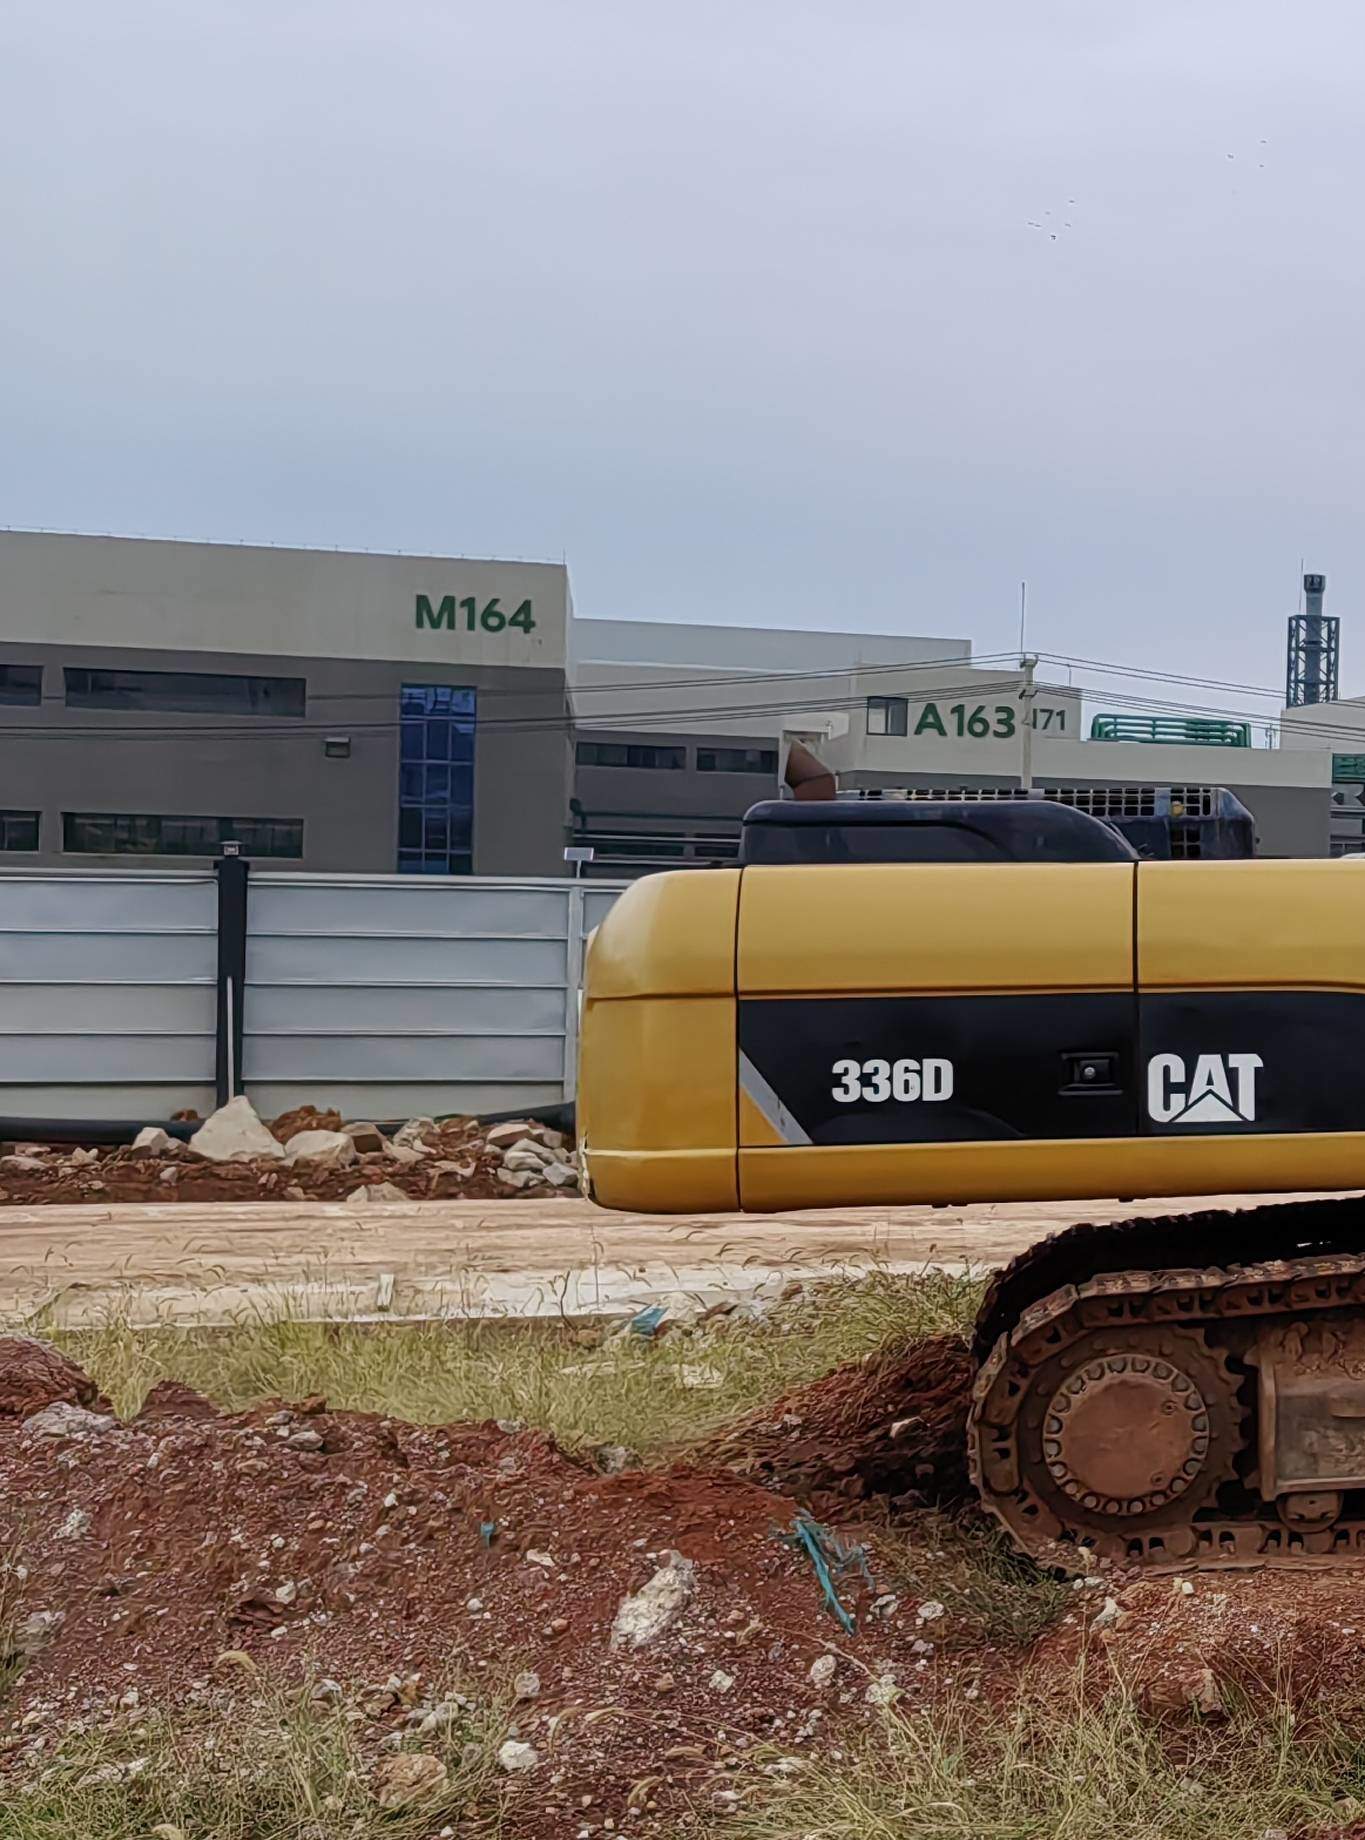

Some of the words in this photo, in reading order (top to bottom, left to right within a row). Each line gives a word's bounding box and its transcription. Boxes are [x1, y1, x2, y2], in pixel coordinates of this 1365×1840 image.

[415, 594, 536, 634] M164
[913, 702, 1016, 738] A163
[831, 1058, 954, 1103] 336D
[1147, 1053, 1263, 1123] CAT
